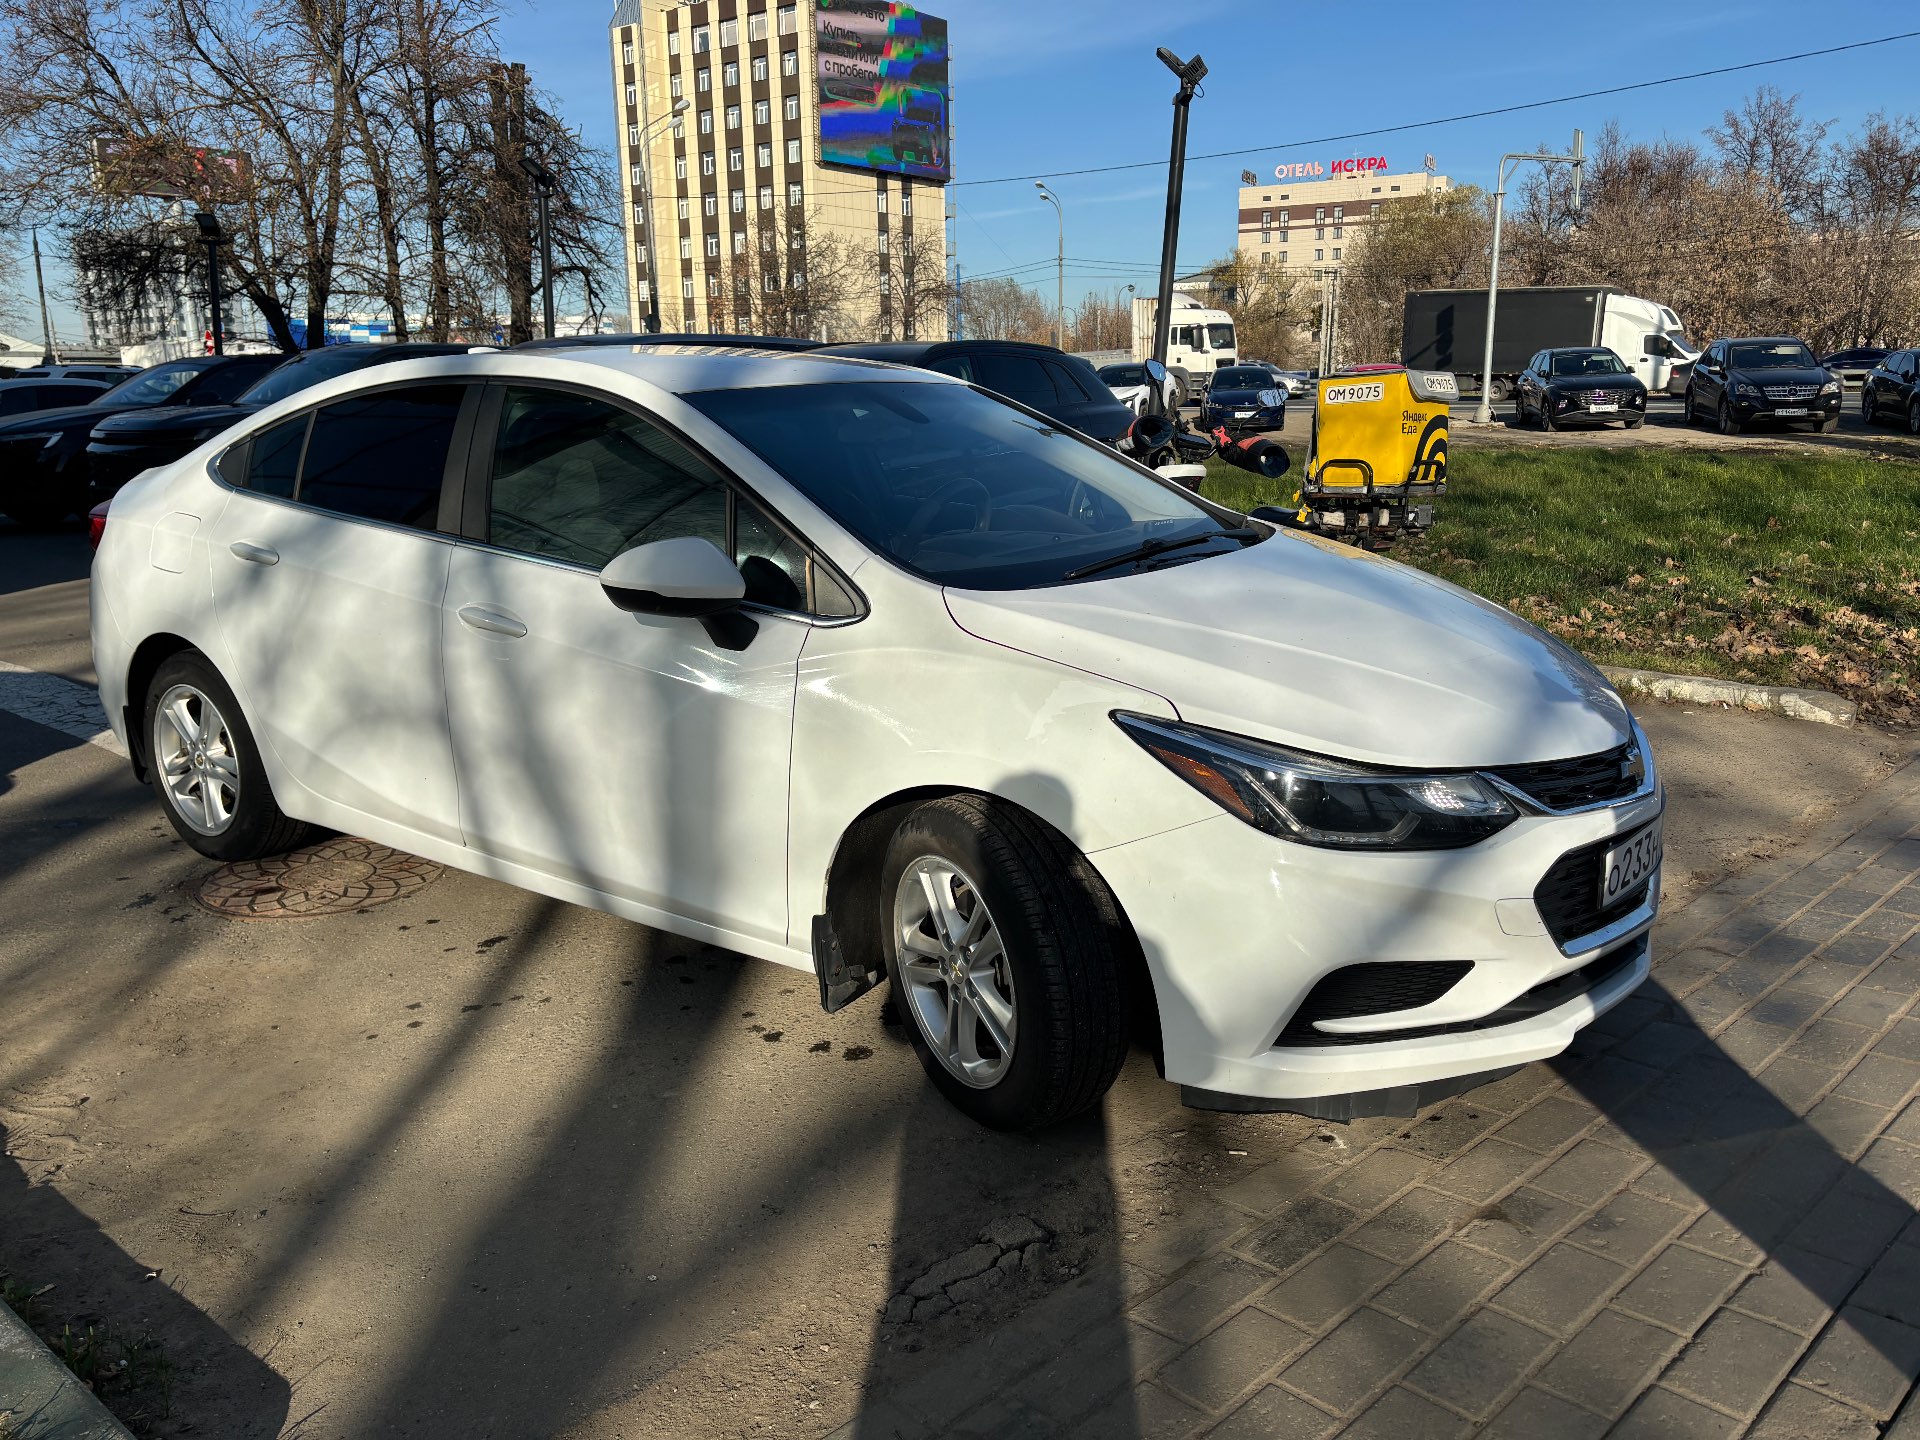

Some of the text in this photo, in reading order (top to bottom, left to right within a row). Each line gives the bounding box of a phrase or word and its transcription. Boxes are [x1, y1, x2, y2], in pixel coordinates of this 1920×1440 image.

[823, 19, 862, 43] Купить
[824, 60, 831, 71] с
[1275, 161, 1324, 178] ОТЕЛЬ
[1331, 156, 1387, 174] ИСКРА
[1402, 411, 1428, 423] Яндекс
[1402, 424, 1417, 435] Еда
